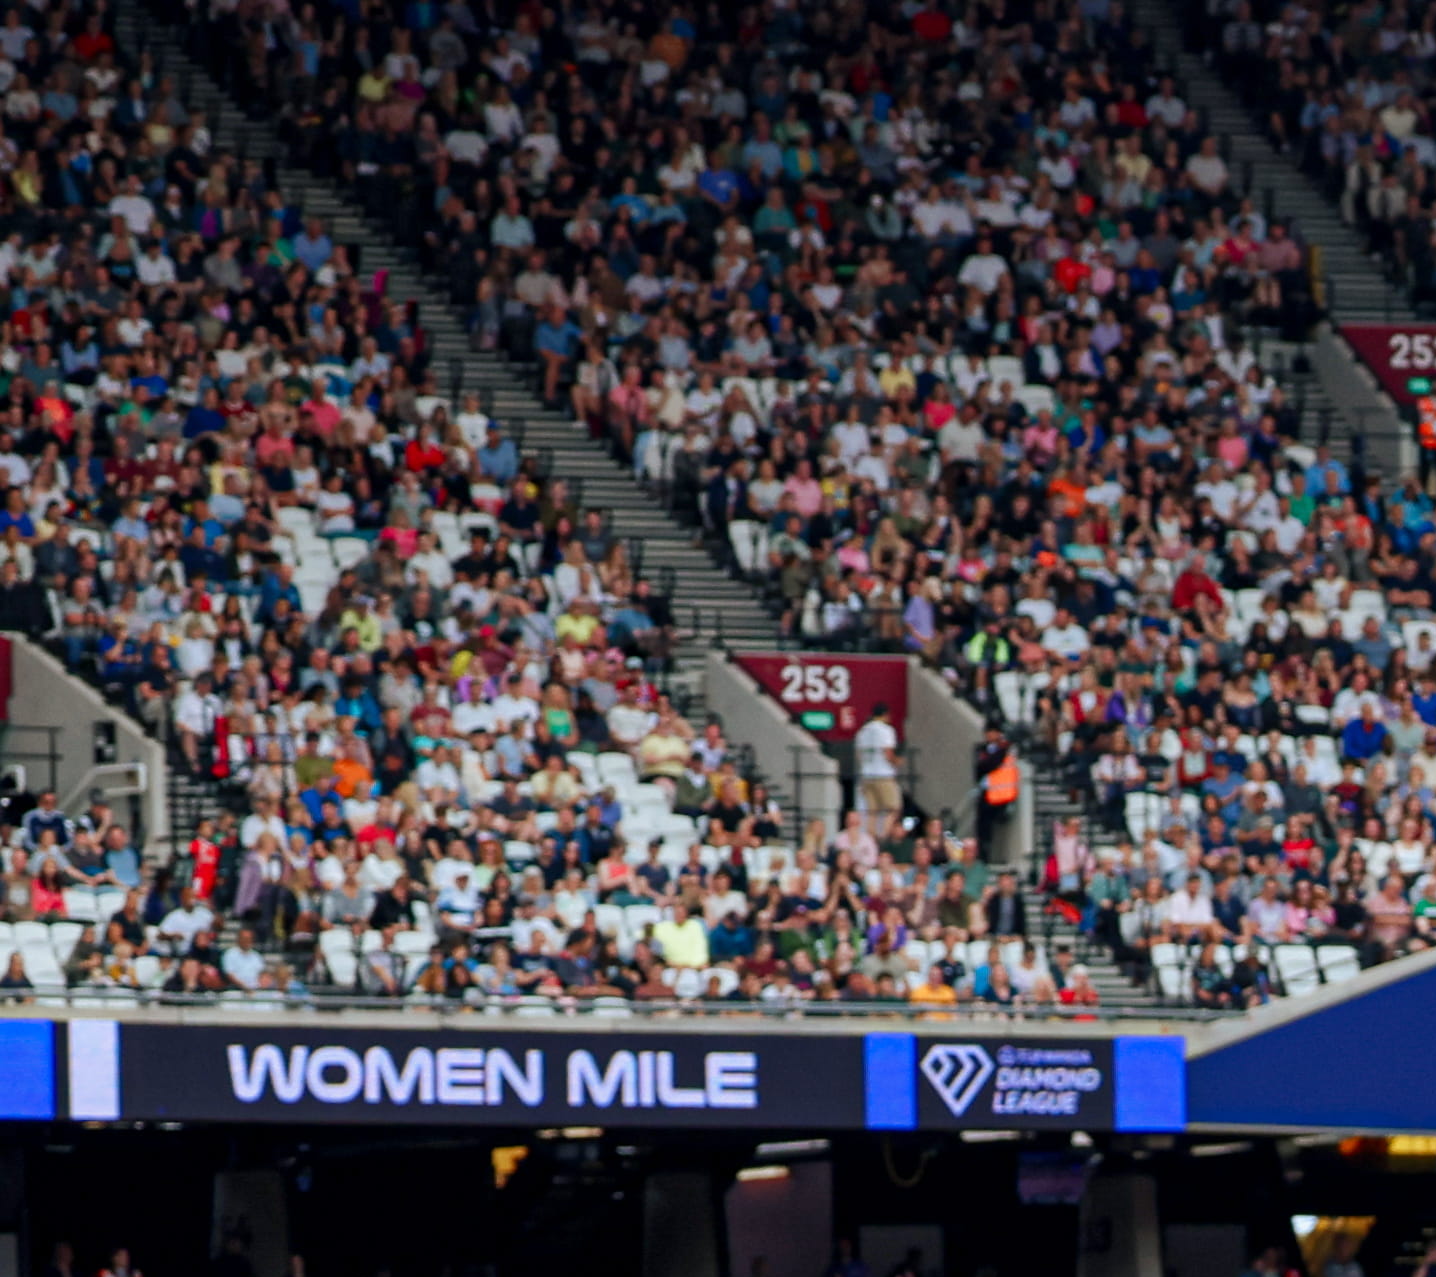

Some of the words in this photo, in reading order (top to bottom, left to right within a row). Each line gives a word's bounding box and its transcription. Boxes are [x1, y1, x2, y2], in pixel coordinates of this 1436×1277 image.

[779, 664, 852, 704] 253
[226, 1043, 544, 1107] WOMEN
[566, 1049, 758, 1109] MILE
[995, 1065, 1102, 1093] DIAMOND
[992, 1089, 1080, 1116] LEAGUE
